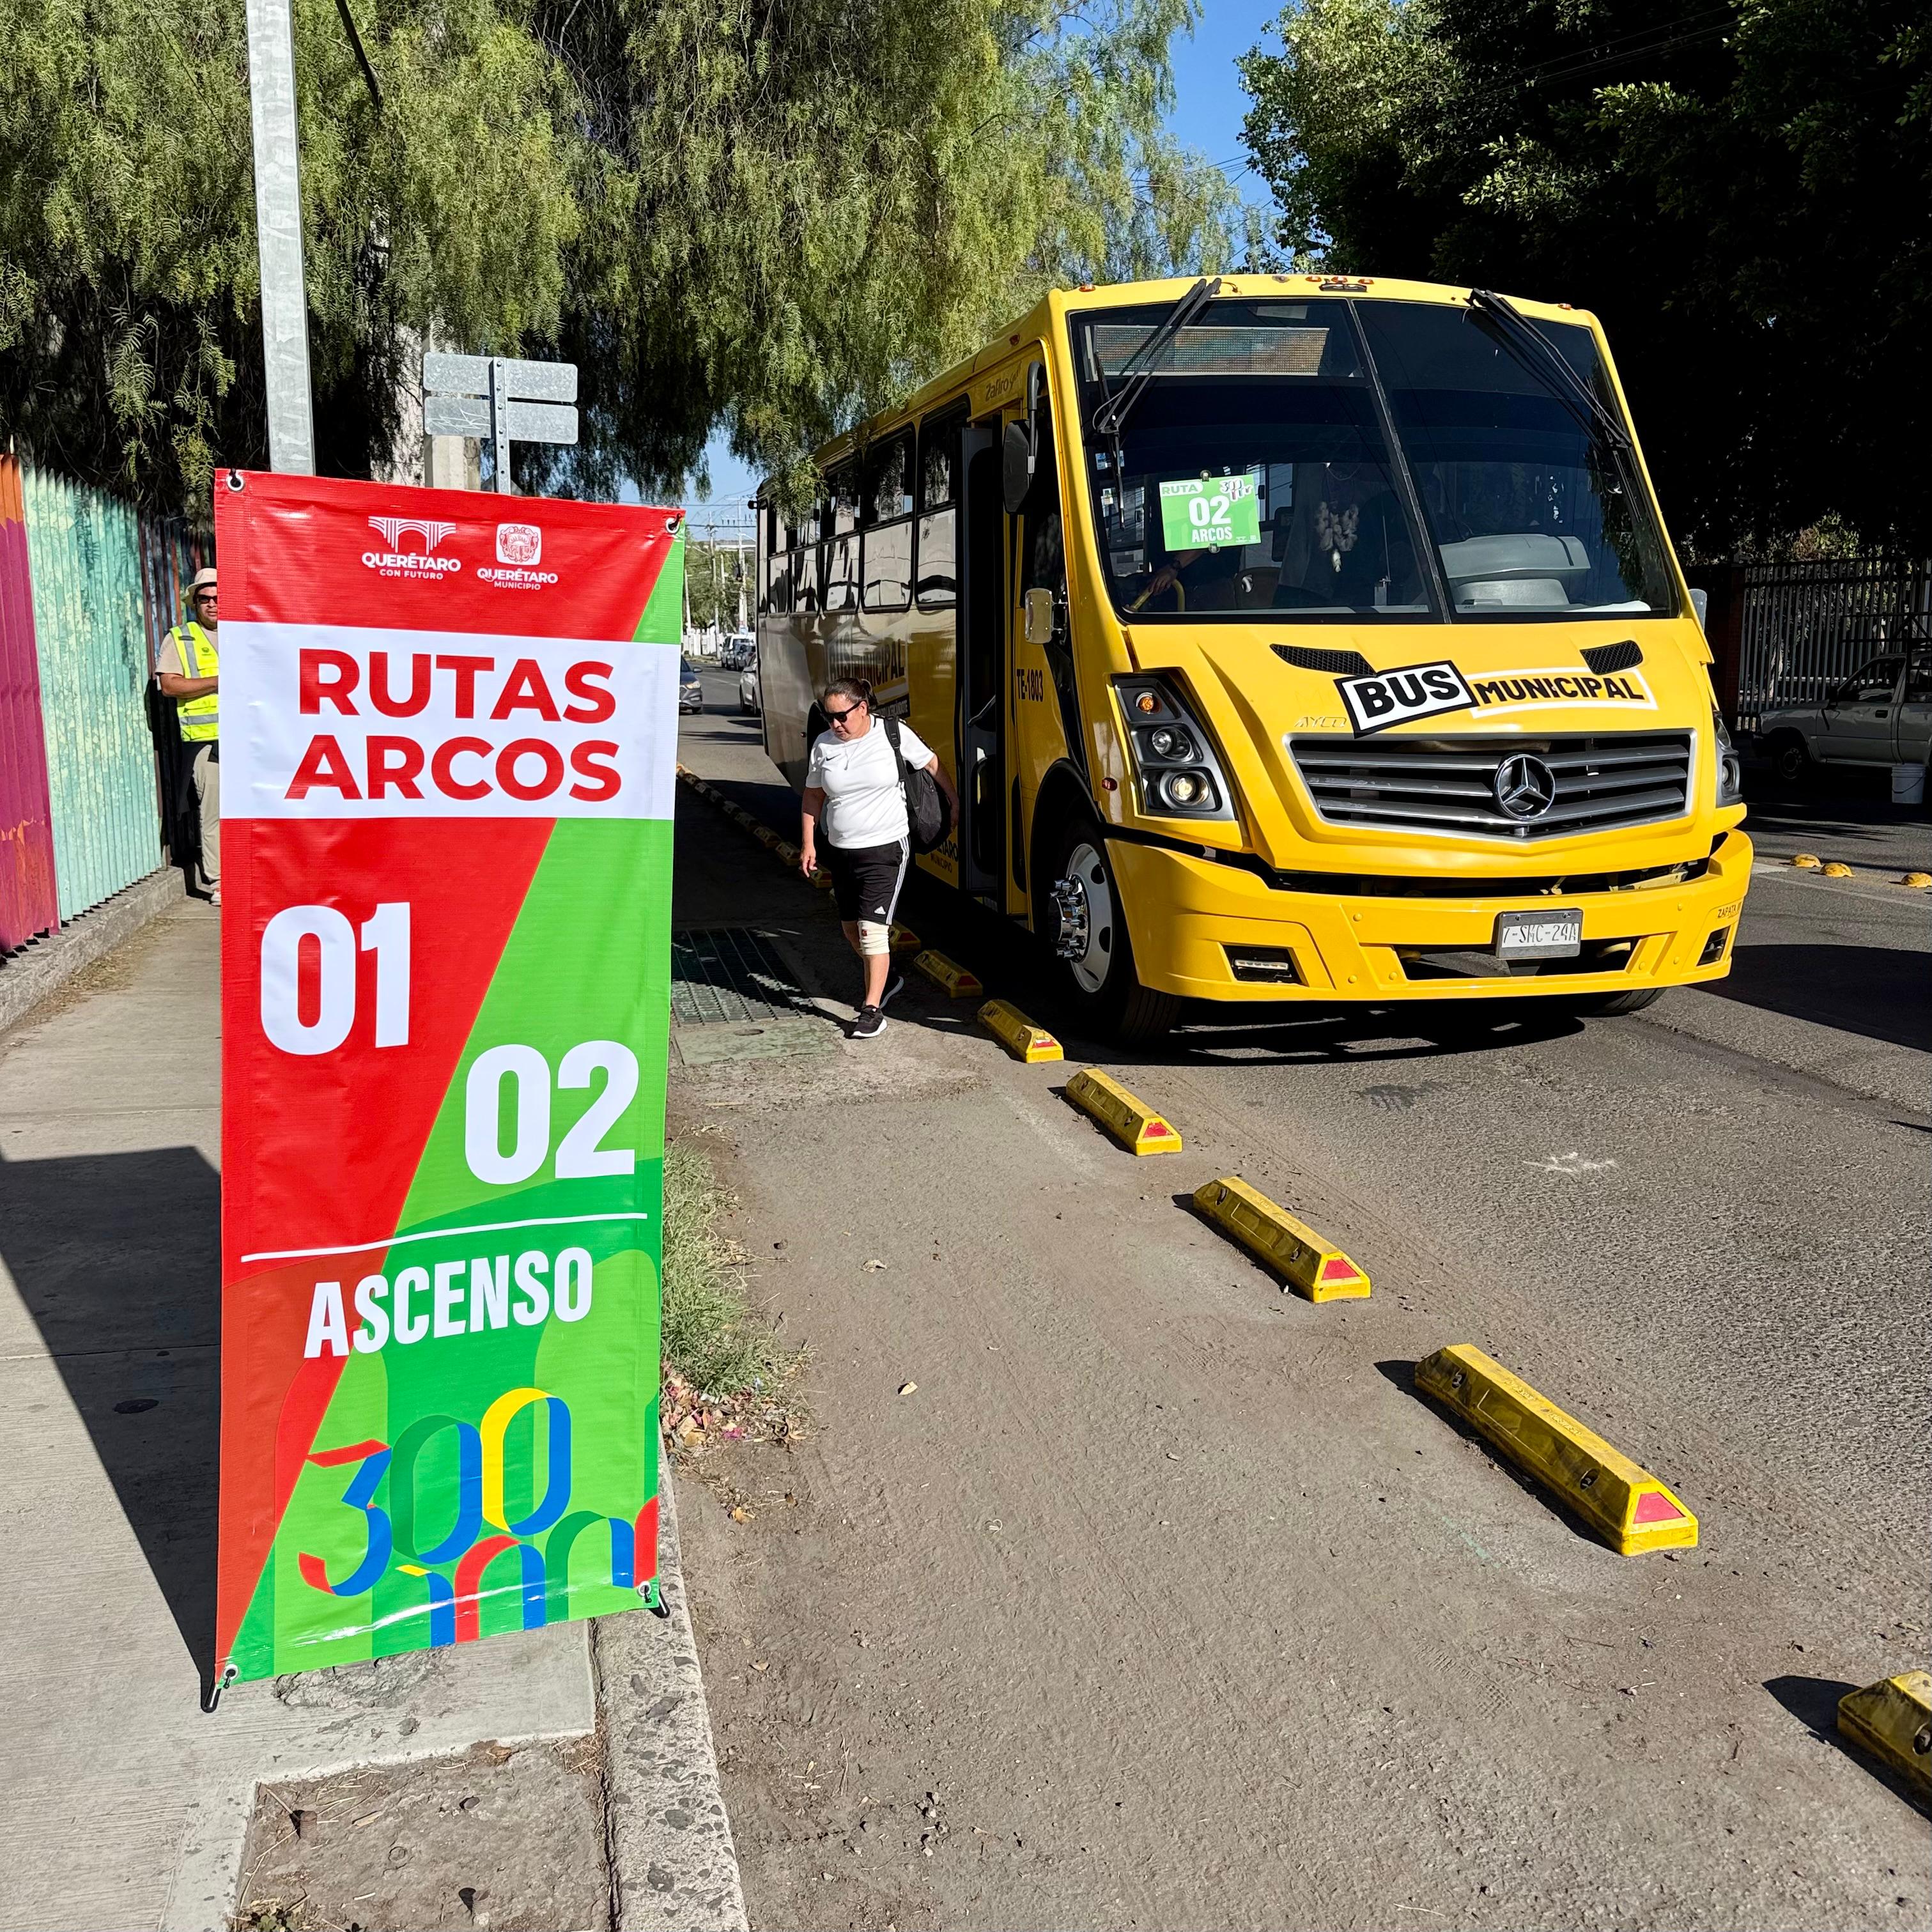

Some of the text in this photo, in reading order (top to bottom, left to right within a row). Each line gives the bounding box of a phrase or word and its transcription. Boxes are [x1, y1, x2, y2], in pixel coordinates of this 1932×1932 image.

[1161, 484, 1198, 495] RUTA
[1188, 495, 1232, 527] 02
[1191, 526, 1233, 543] ARCOS
[361, 552, 461, 572] QUERÉTARO
[379, 569, 444, 580] CON FUTURO
[477, 568, 559, 584] QUERÉTARO
[493, 580, 541, 591] MUNICIPIO
[299, 648, 616, 724] RUTAS
[1017, 668, 1044, 702] TE-1803
[1353, 670, 1645, 719] BUS MUNICIPAL
[284, 734, 622, 802] ARCOS
[260, 901, 411, 1056] 01
[464, 1040, 640, 1185] 02
[303, 1246, 593, 1359] ASCENSO
